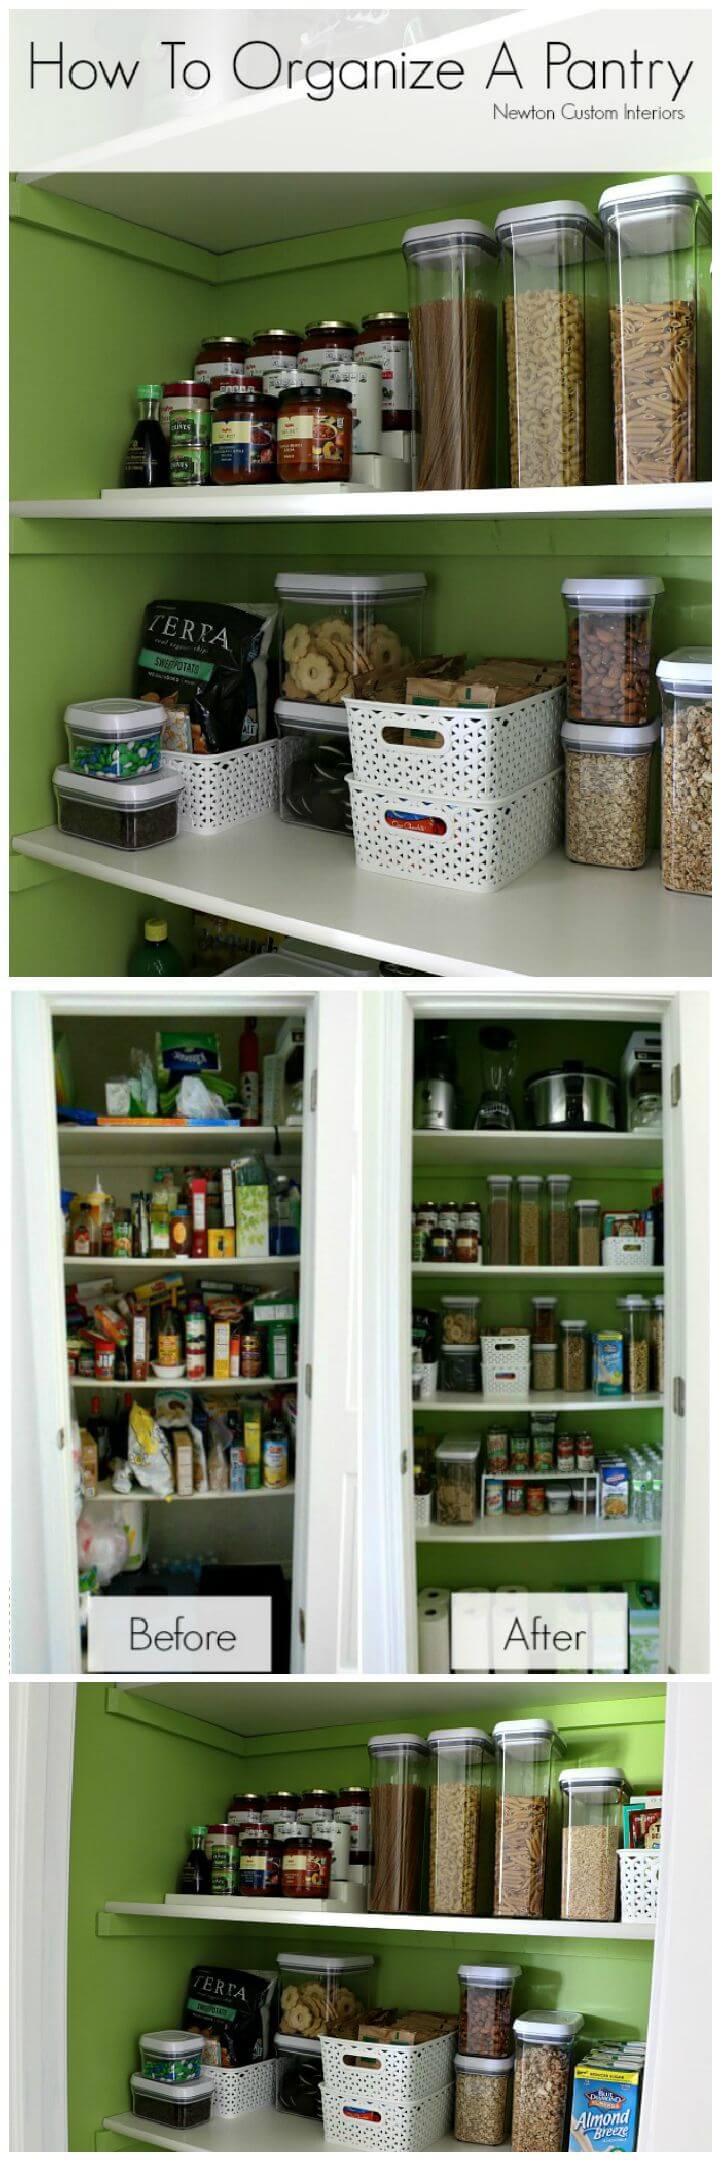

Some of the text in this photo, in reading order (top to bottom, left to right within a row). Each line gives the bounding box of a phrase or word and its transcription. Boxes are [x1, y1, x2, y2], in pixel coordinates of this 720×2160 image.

[147, 614, 230, 651] TERRA
[193, 1975, 246, 2001] TERRA
[598, 2089, 613, 2097] BLUE
[574, 2109, 630, 2131] Almond
[594, 2127, 629, 2140] Breeze
